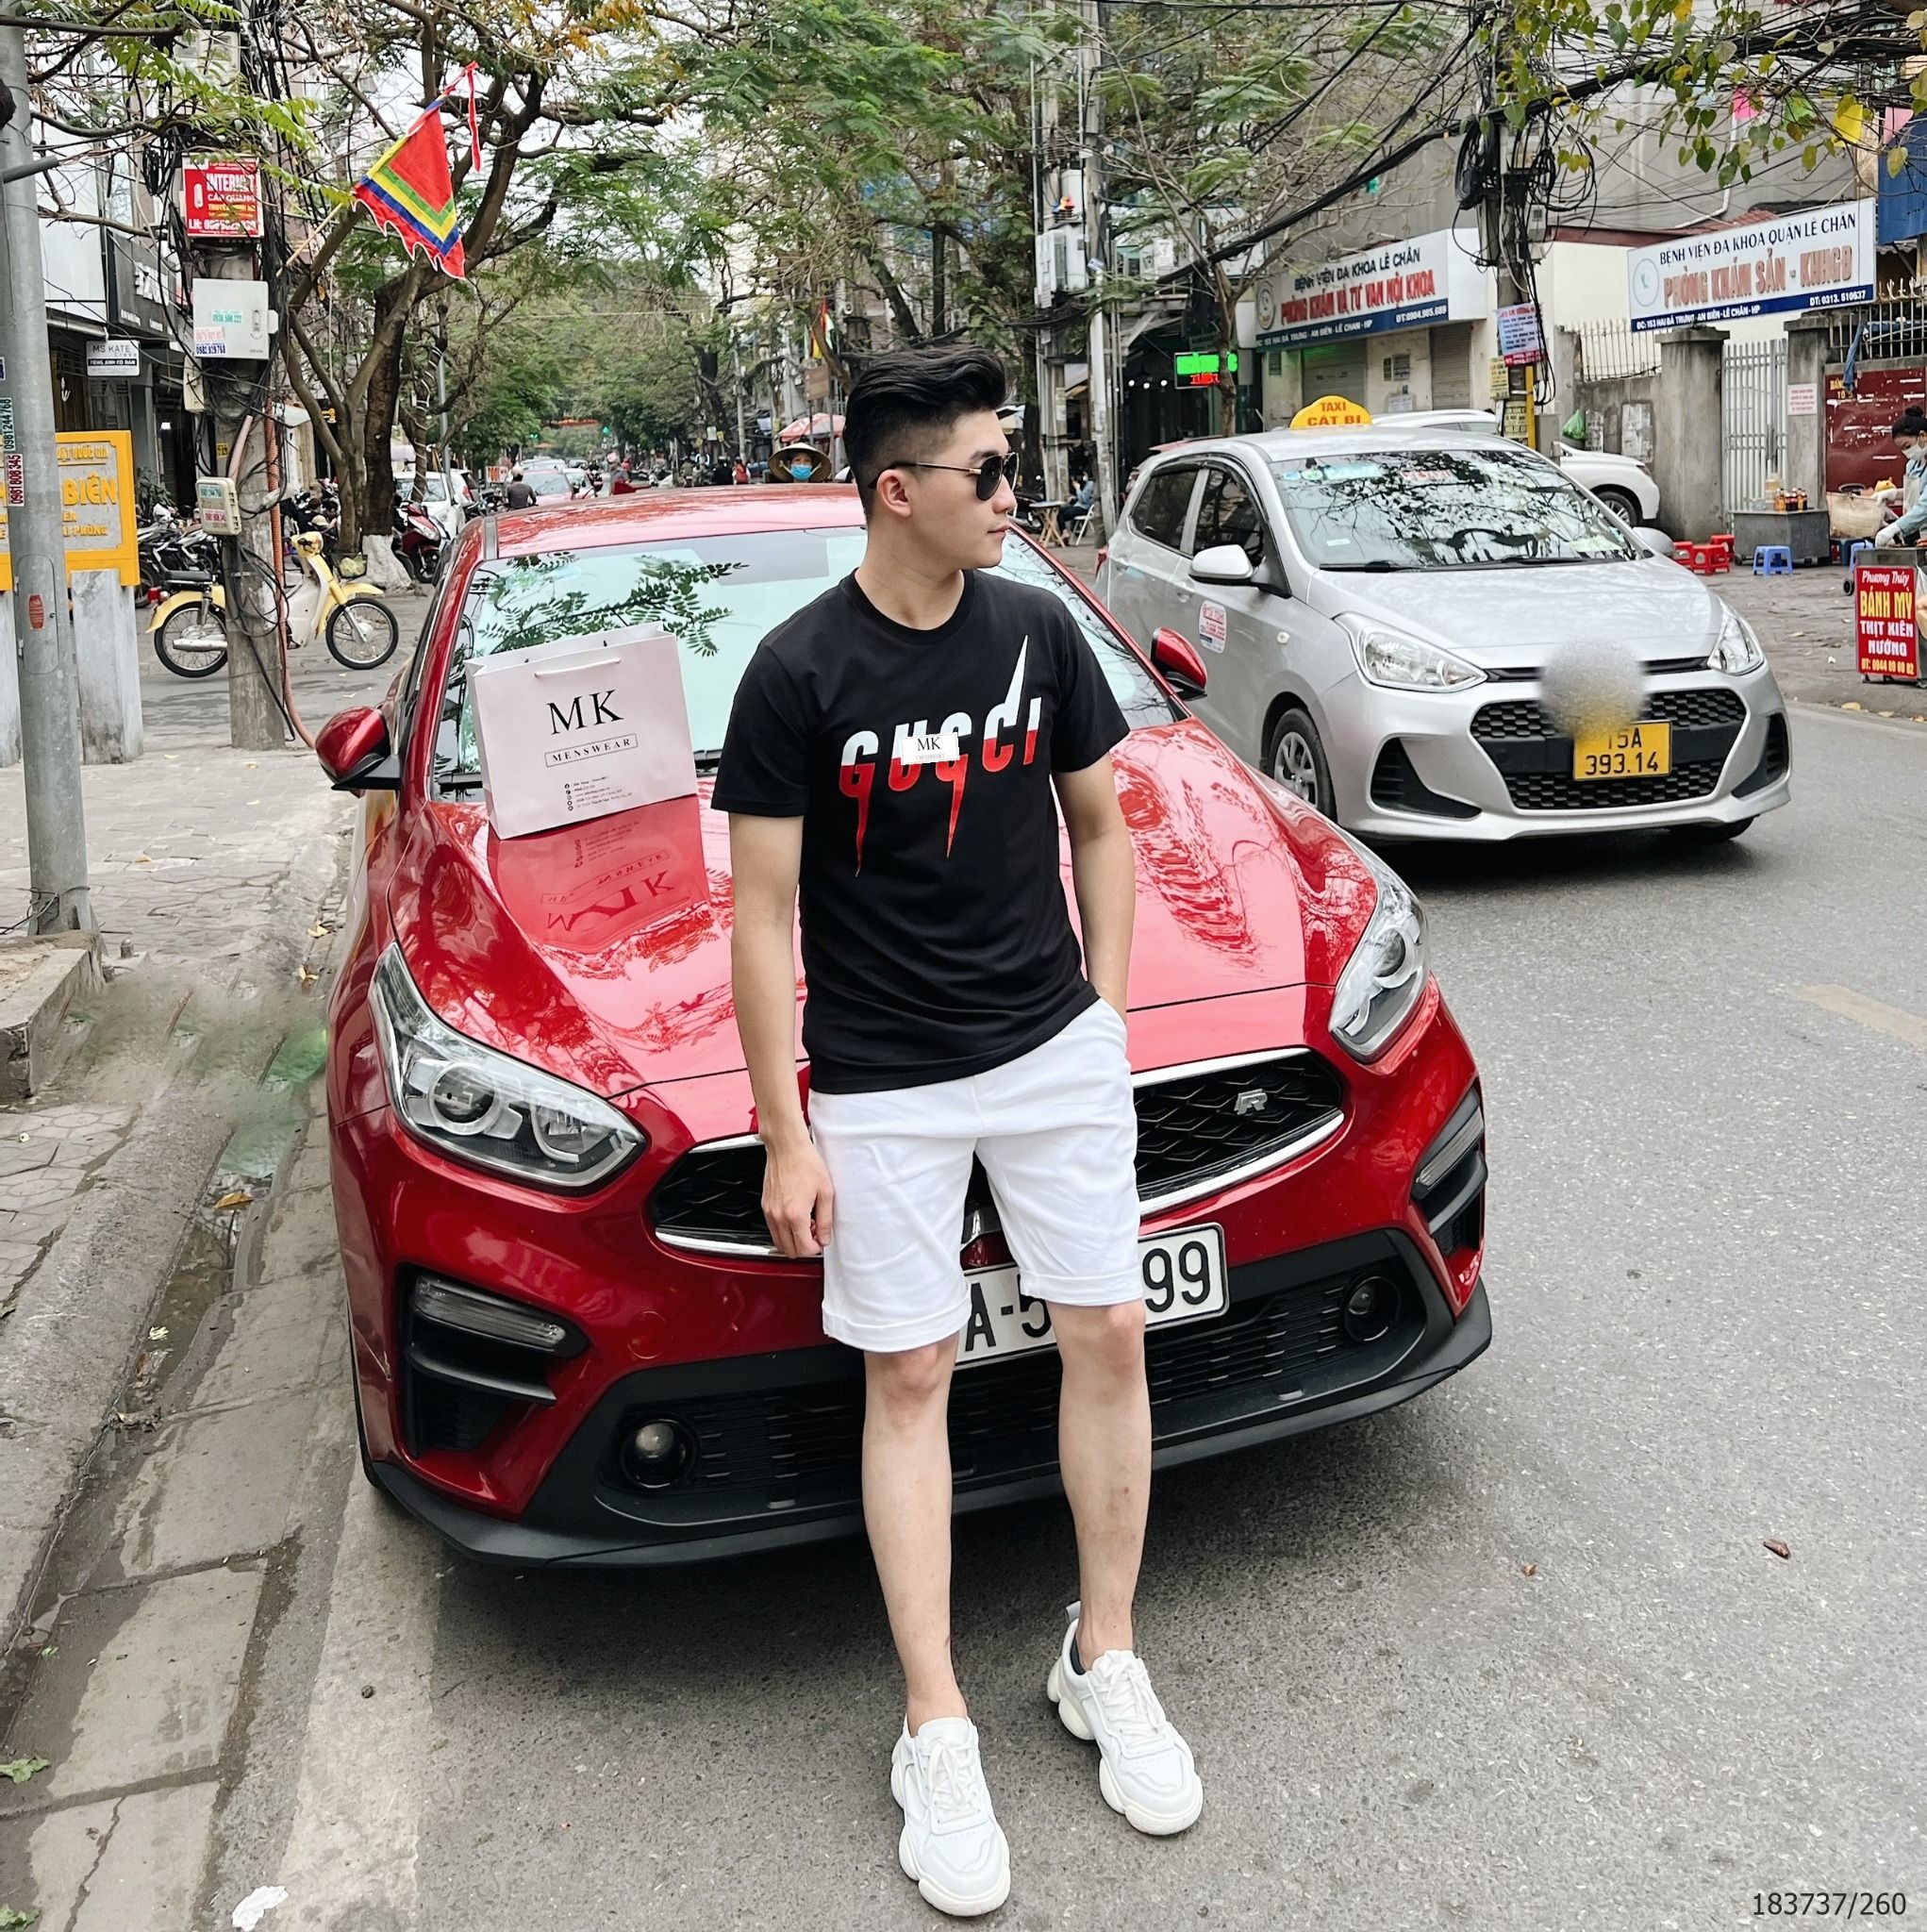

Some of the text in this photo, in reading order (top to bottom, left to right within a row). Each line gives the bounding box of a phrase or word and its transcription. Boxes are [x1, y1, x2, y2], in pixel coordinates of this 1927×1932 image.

[1660, 210, 1855, 268] BỆNH VIỆN ĐA KHOA QUẬN LÊ CHÂN
[1352, 259, 1376, 277] KHOA
[1393, 246, 1420, 267] CHÂN
[1406, 269, 1436, 301] KHOA
[1664, 265, 1708, 309] PHÒNG
[1711, 257, 1752, 301] KHÁM
[1755, 247, 1786, 293] SẢN
[92, 344, 130, 353] MS KATE
[1321, 401, 1346, 412] TAXI
[1344, 415, 1361, 425] BI
[62, 472, 118, 506] BIÊN
[1861, 570, 1890, 587] Phương
[1860, 585, 1913, 620] BÁNH MỲ
[1859, 619, 1914, 638] THỊT XIÊN
[1868, 638, 1907, 658] NƯỚNG
[546, 689, 624, 735] MK
[552, 738, 631, 762] MENSWEAR
[918, 737, 940, 751] MK
[1586, 751, 1658, 775] 393.14
[1142, 1241, 1211, 1313] 99
